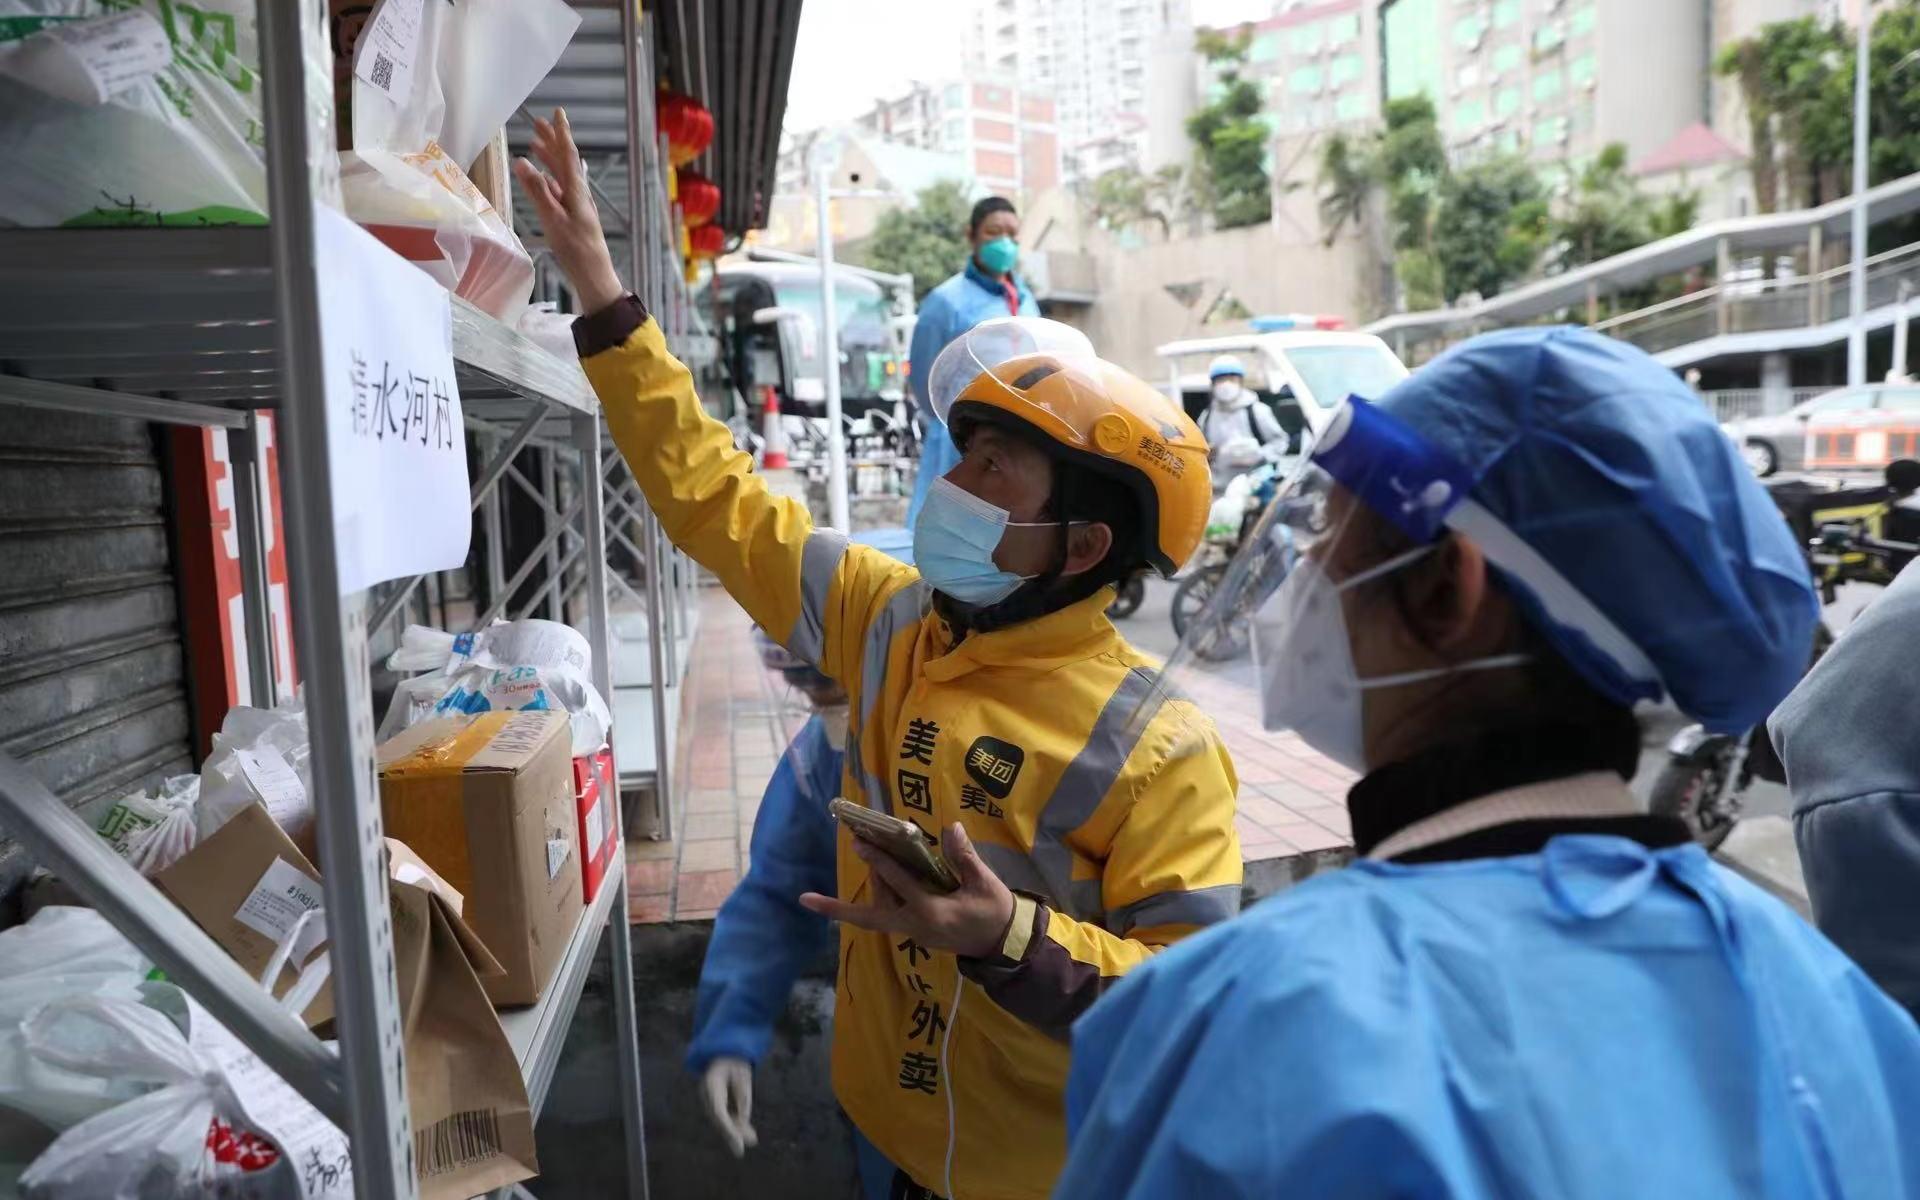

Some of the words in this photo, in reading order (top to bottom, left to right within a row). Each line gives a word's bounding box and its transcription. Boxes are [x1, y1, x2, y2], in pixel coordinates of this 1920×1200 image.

[349, 346, 453, 450] 清水河村
[1138, 435, 1185, 473] 美团外卖
[897, 717, 941, 816] 美团
[968, 747, 1017, 784] 美团
